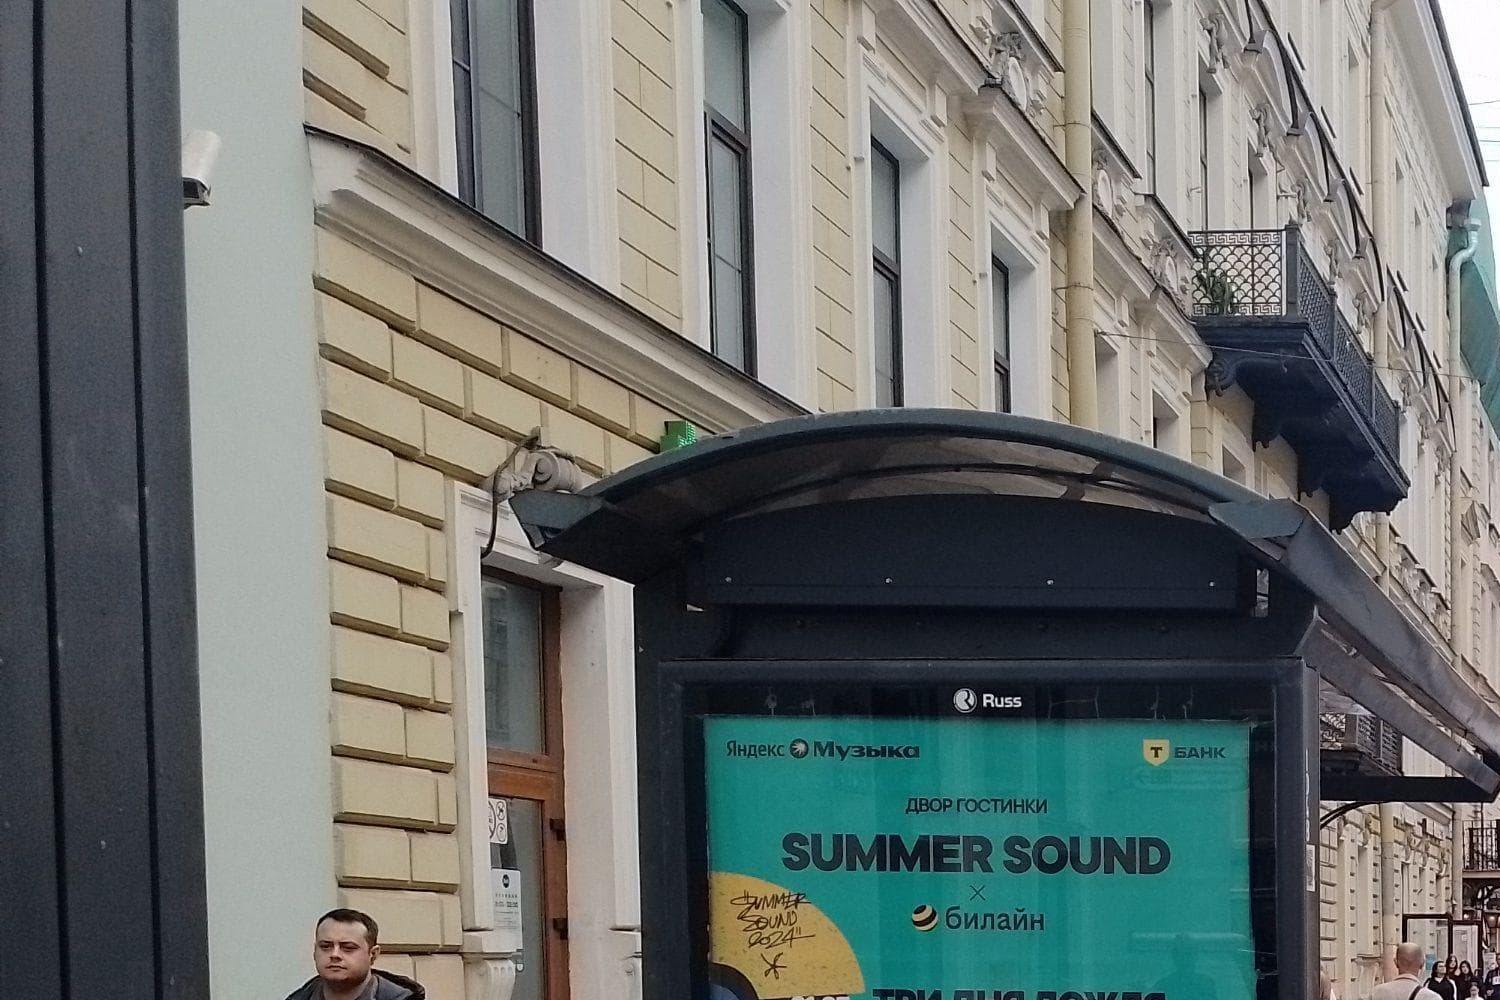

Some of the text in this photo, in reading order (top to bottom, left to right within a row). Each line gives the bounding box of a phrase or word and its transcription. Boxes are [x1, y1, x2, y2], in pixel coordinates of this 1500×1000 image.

[983, 693, 1022, 708] Russ
[726, 741, 920, 761] Яндекс Музыка
[1174, 747, 1226, 758] БАНК
[905, 797, 1048, 815] ДВОР ГОСТИНКИ
[781, 833, 1170, 875] SUMMER SOUND
[945, 905, 1045, 931] билайн
